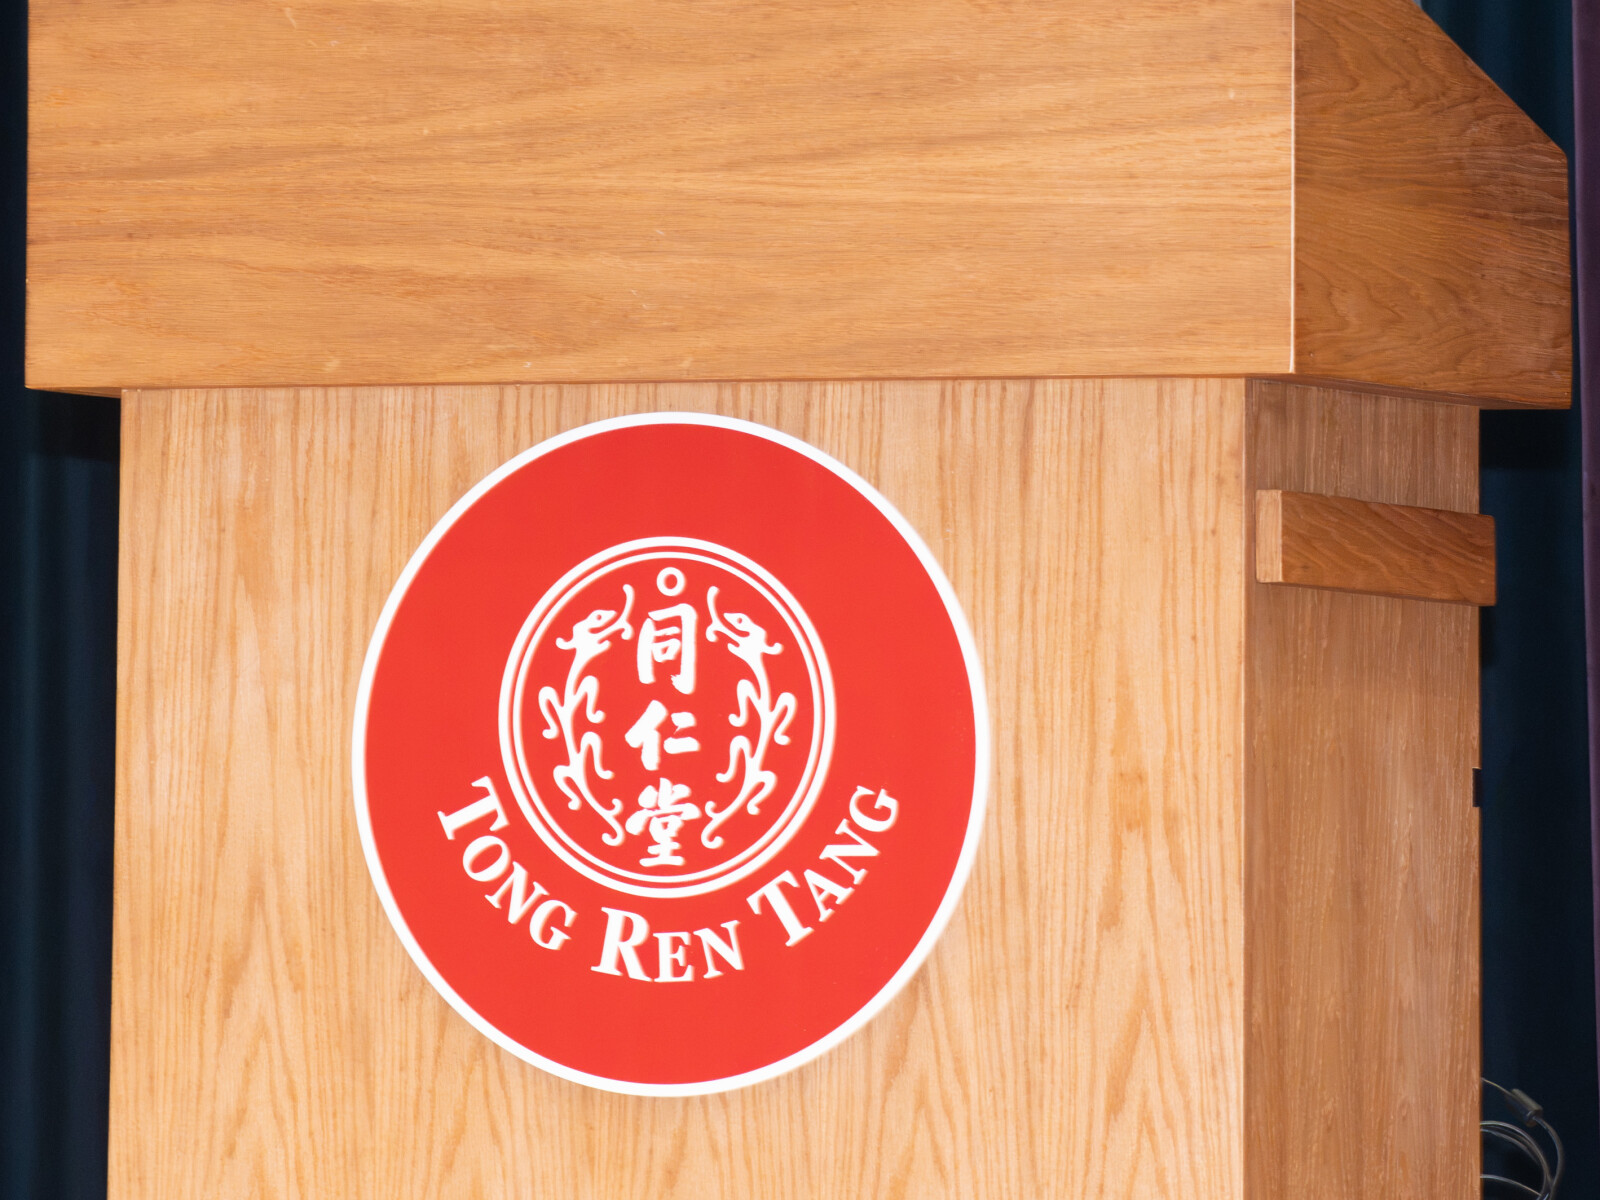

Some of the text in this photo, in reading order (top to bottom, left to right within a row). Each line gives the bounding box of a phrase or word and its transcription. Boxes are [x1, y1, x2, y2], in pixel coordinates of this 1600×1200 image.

[624, 602, 702, 868] 同仁堂
[437, 775, 900, 983] TONG REN TANG
